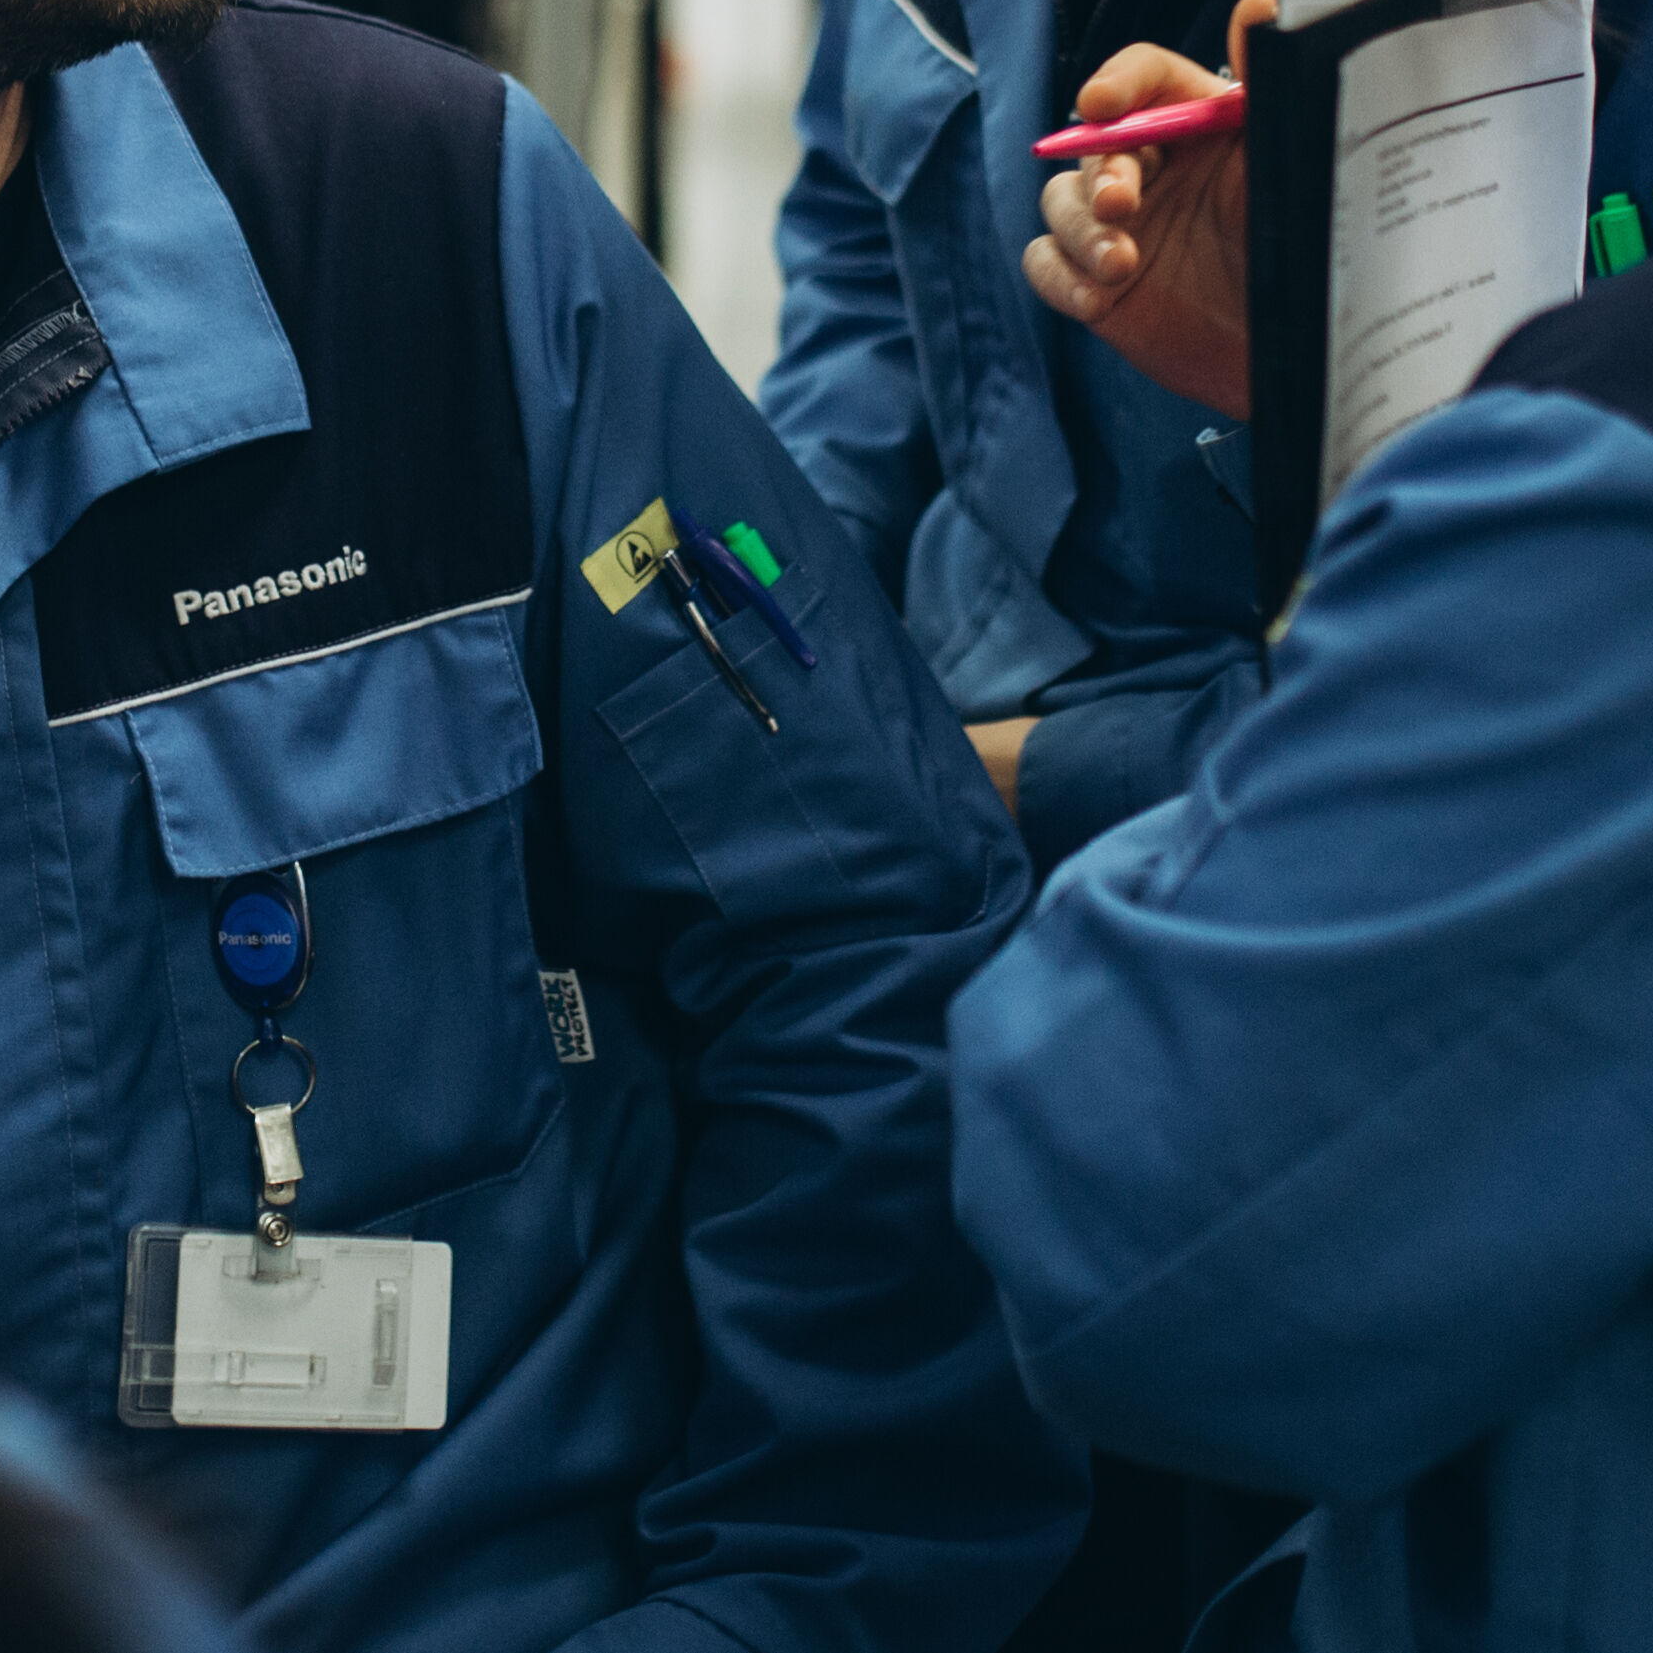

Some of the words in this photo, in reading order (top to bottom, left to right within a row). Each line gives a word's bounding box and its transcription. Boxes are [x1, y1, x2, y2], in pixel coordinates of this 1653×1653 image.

[173, 544, 367, 626] Panasonic
[217, 930, 292, 946] Panasonic
[543, 977, 575, 1058] WORK
[560, 979, 590, 1057] PROTECT
